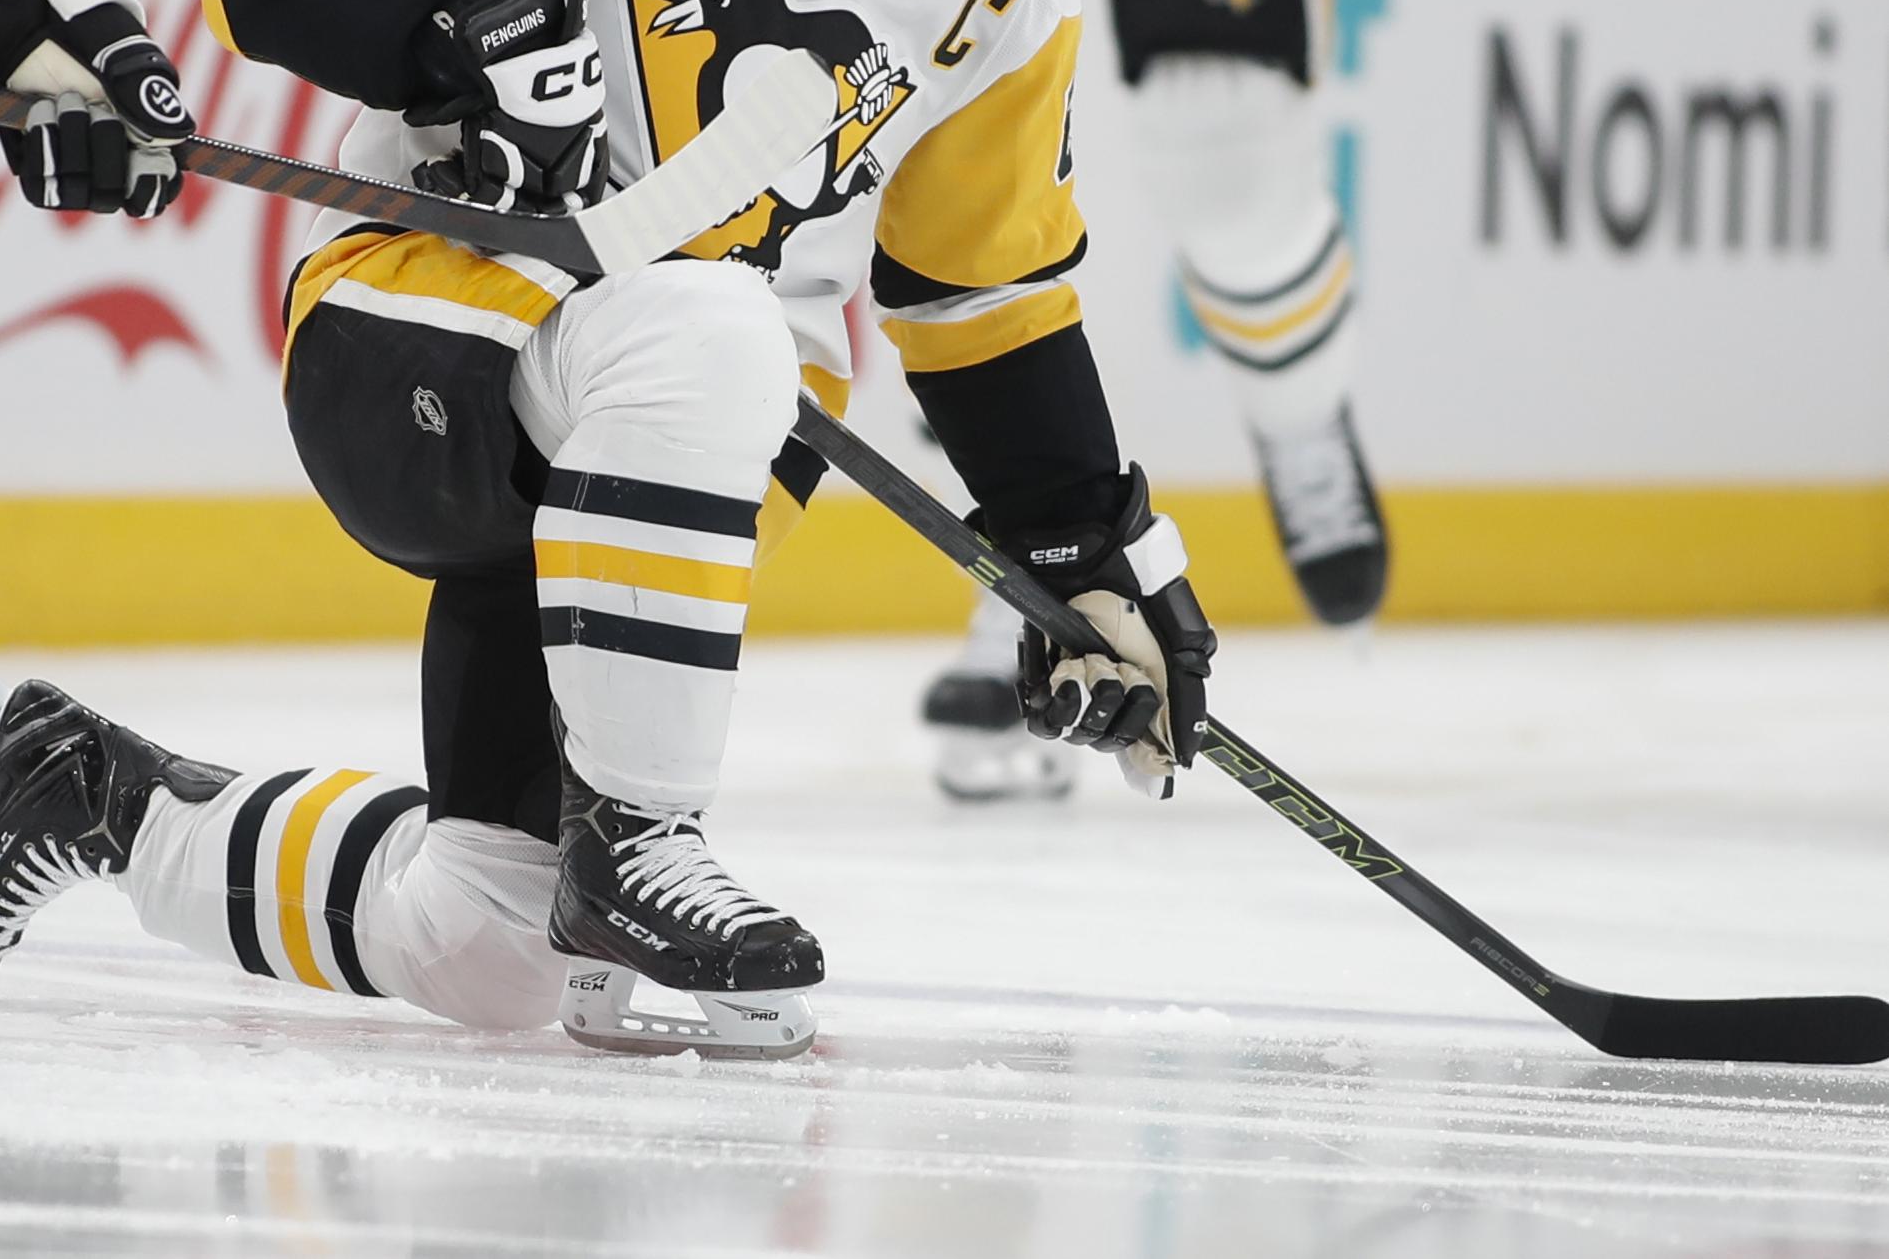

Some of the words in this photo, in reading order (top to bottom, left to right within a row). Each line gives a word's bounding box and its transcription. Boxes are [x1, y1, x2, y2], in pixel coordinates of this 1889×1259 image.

[480, 7, 547, 53] PENGUINS
[1479, 12, 1836, 254] Nomi
[1029, 545, 1079, 561] CCM
[607, 909, 672, 952] CCM
[568, 979, 606, 992] CCM
